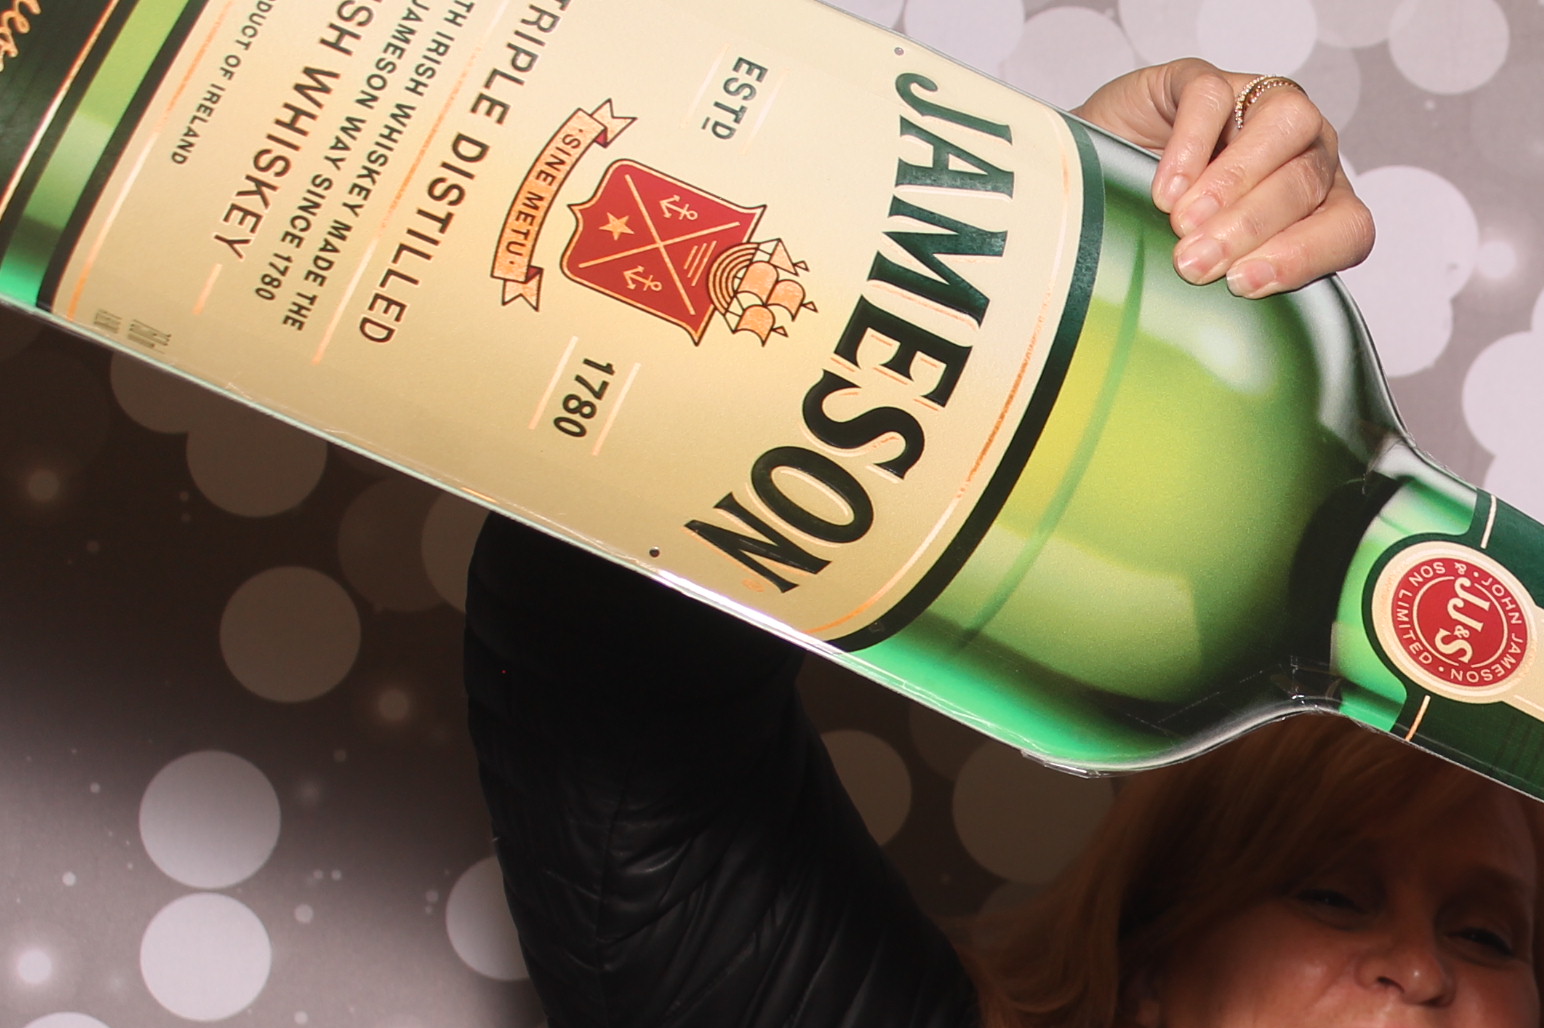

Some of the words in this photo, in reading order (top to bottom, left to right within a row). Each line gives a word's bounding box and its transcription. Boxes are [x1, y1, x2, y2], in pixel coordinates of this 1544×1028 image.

[220, 54, 241, 80] OF
[405, 31, 455, 96] IRISH
[701, 56, 768, 140] ESTD
[171, 83, 226, 165] IRELAND
[324, 116, 366, 170] WAY
[214, 66, 341, 259] WHISKEY
[342, 103, 416, 217] WHISKEY
[280, 174, 333, 248] SINCE
[355, 133, 489, 343] DISTILLED
[255, 253, 293, 300] 1780
[304, 219, 353, 287] MADE
[282, 292, 318, 331] THE
[684, 71, 1015, 593] JAMESON
[553, 358, 615, 438] 1780
[1408, 562, 1446, 587] SON
[1481, 577, 1523, 624] JOHN
[1397, 589, 1433, 665] LIMITED
[1450, 633, 1524, 683] JAMESON
